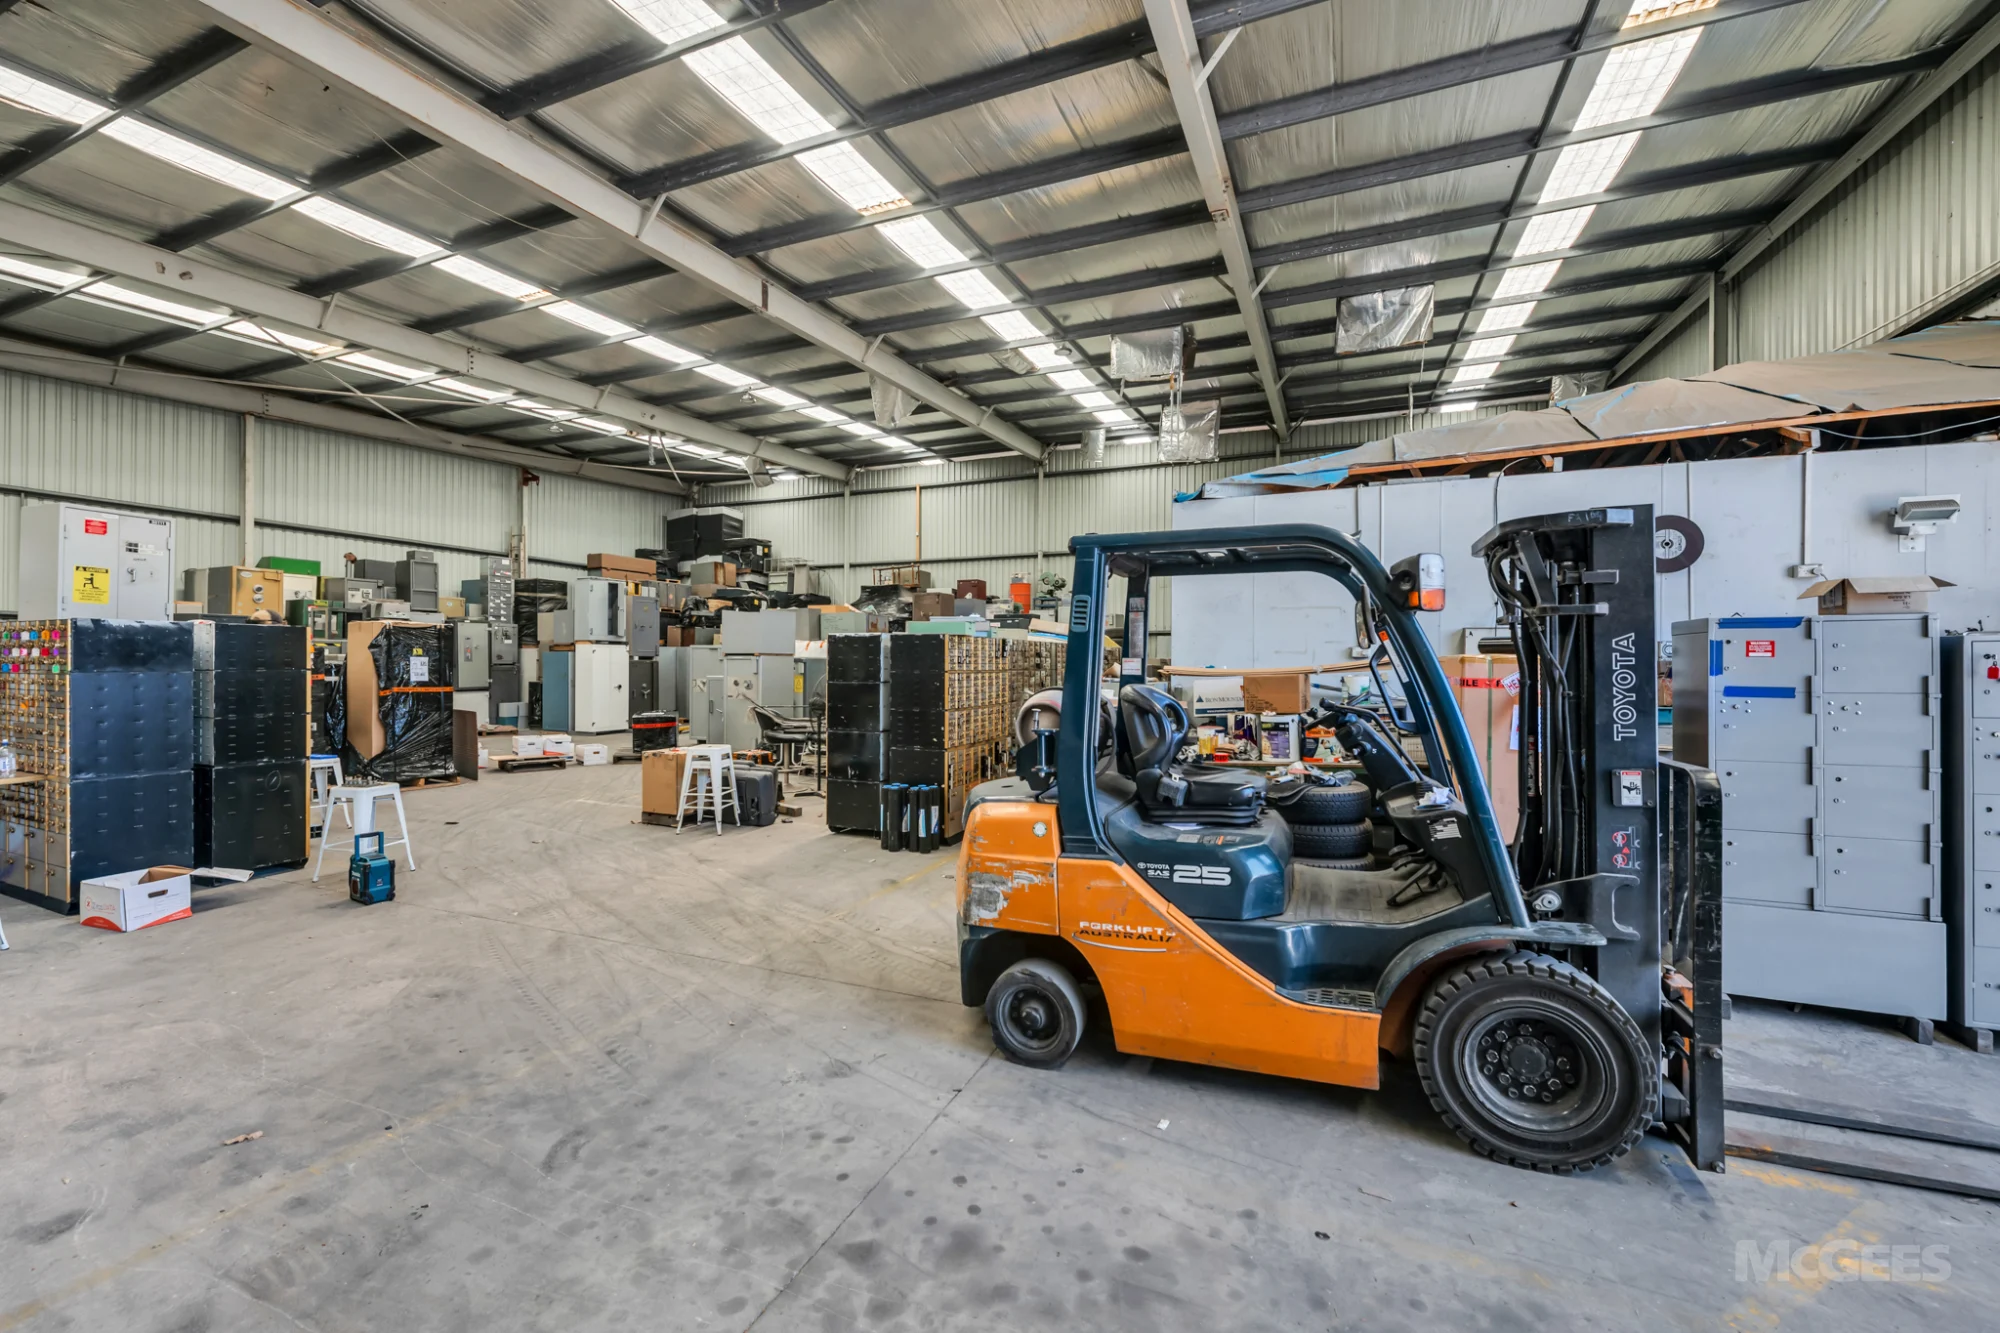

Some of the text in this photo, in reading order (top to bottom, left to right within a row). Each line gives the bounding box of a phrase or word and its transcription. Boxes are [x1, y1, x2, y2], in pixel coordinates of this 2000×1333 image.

[1612, 632, 1637, 742] TOYOTA
[1147, 869, 1170, 877] SAS
[1173, 863, 1232, 886] 25
